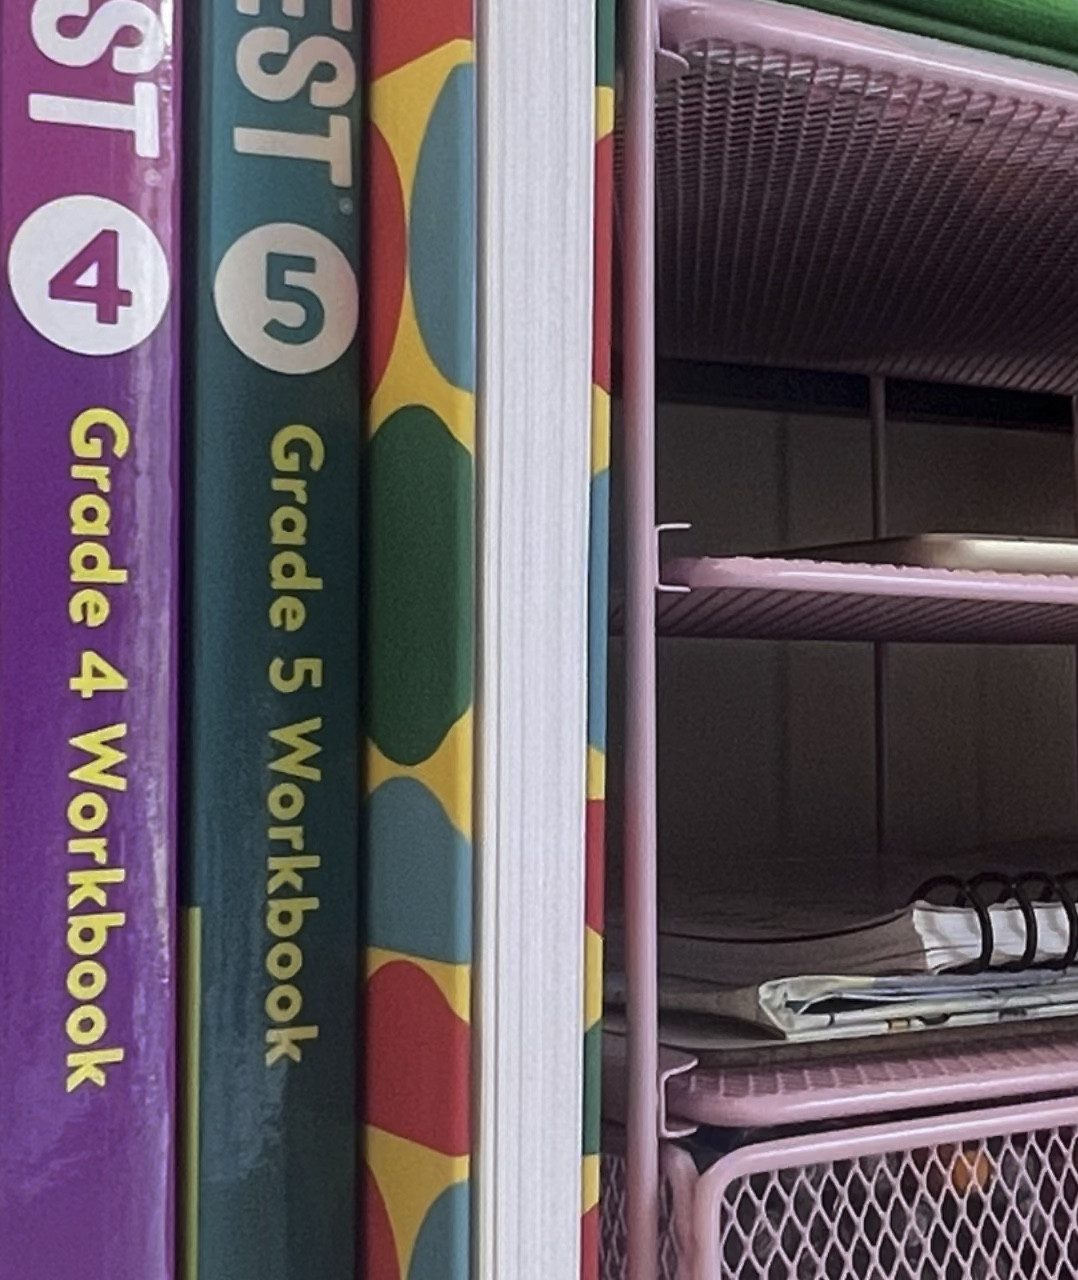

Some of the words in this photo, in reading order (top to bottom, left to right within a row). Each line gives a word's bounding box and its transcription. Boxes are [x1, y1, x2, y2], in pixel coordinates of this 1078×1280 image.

[48, 228, 133, 324] 4
[262, 252, 326, 345] 5
[68, 407, 130, 628] Grade
[269, 423, 326, 632] Grade
[69, 651, 128, 699] 4
[269, 657, 323, 694] 5
[65, 723, 129, 1092] Workbook
[264, 716, 322, 1064] Workbook
